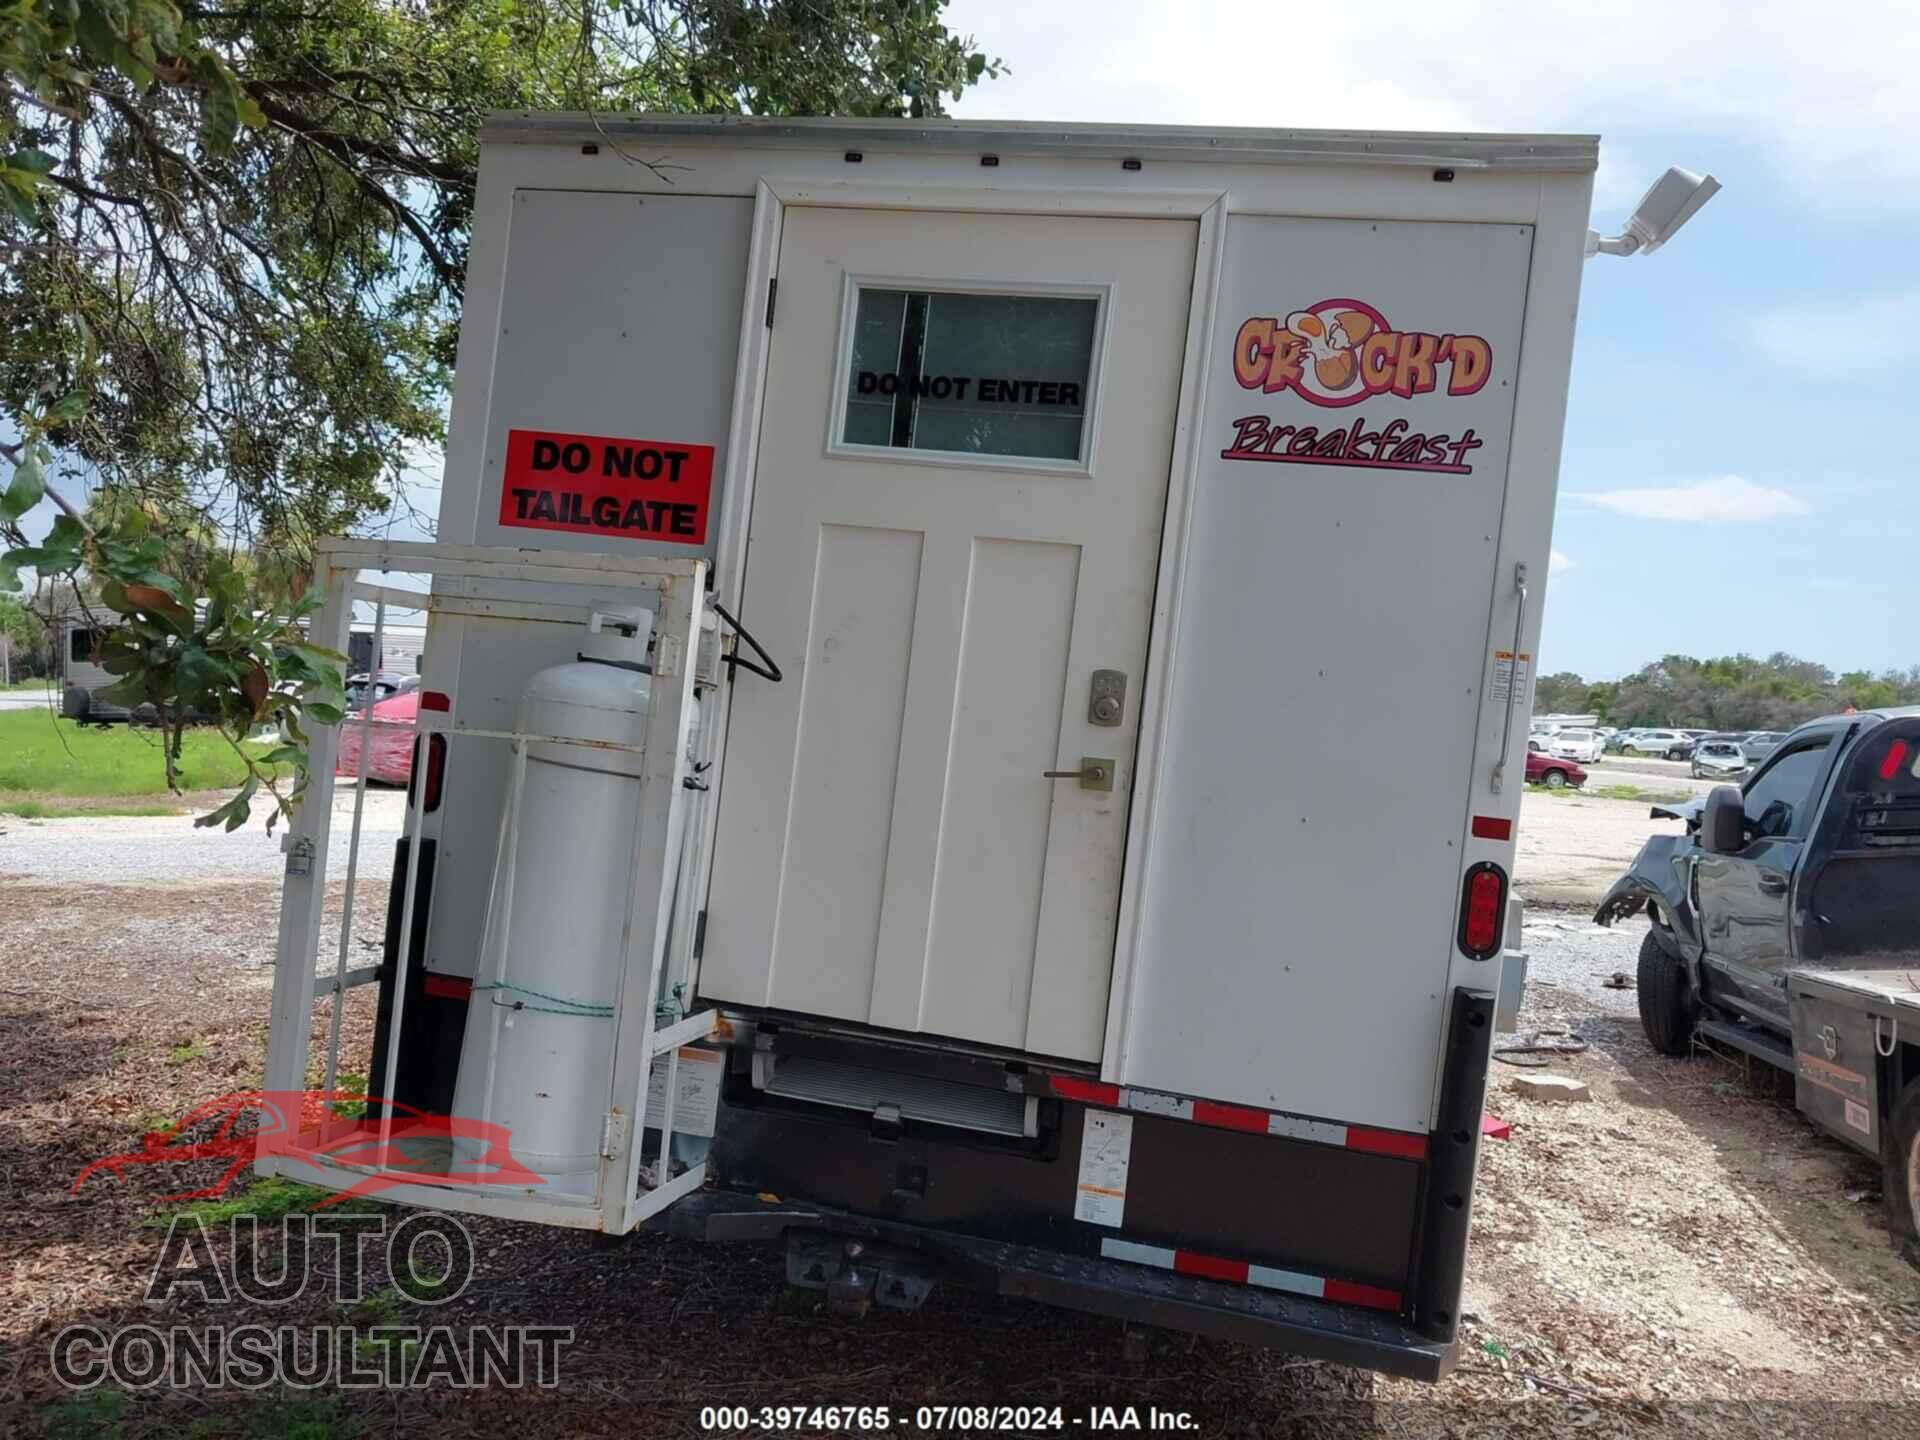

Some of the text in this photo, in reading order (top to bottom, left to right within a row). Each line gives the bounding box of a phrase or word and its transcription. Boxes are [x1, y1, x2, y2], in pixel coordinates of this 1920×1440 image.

[1233, 311, 1492, 399] CRCK'D
[857, 371, 1080, 406] DO NOT ENTER
[531, 439, 689, 483] DO NOT
[1232, 415, 1482, 468] Breakfast
[511, 488, 698, 536] TAILGATE
